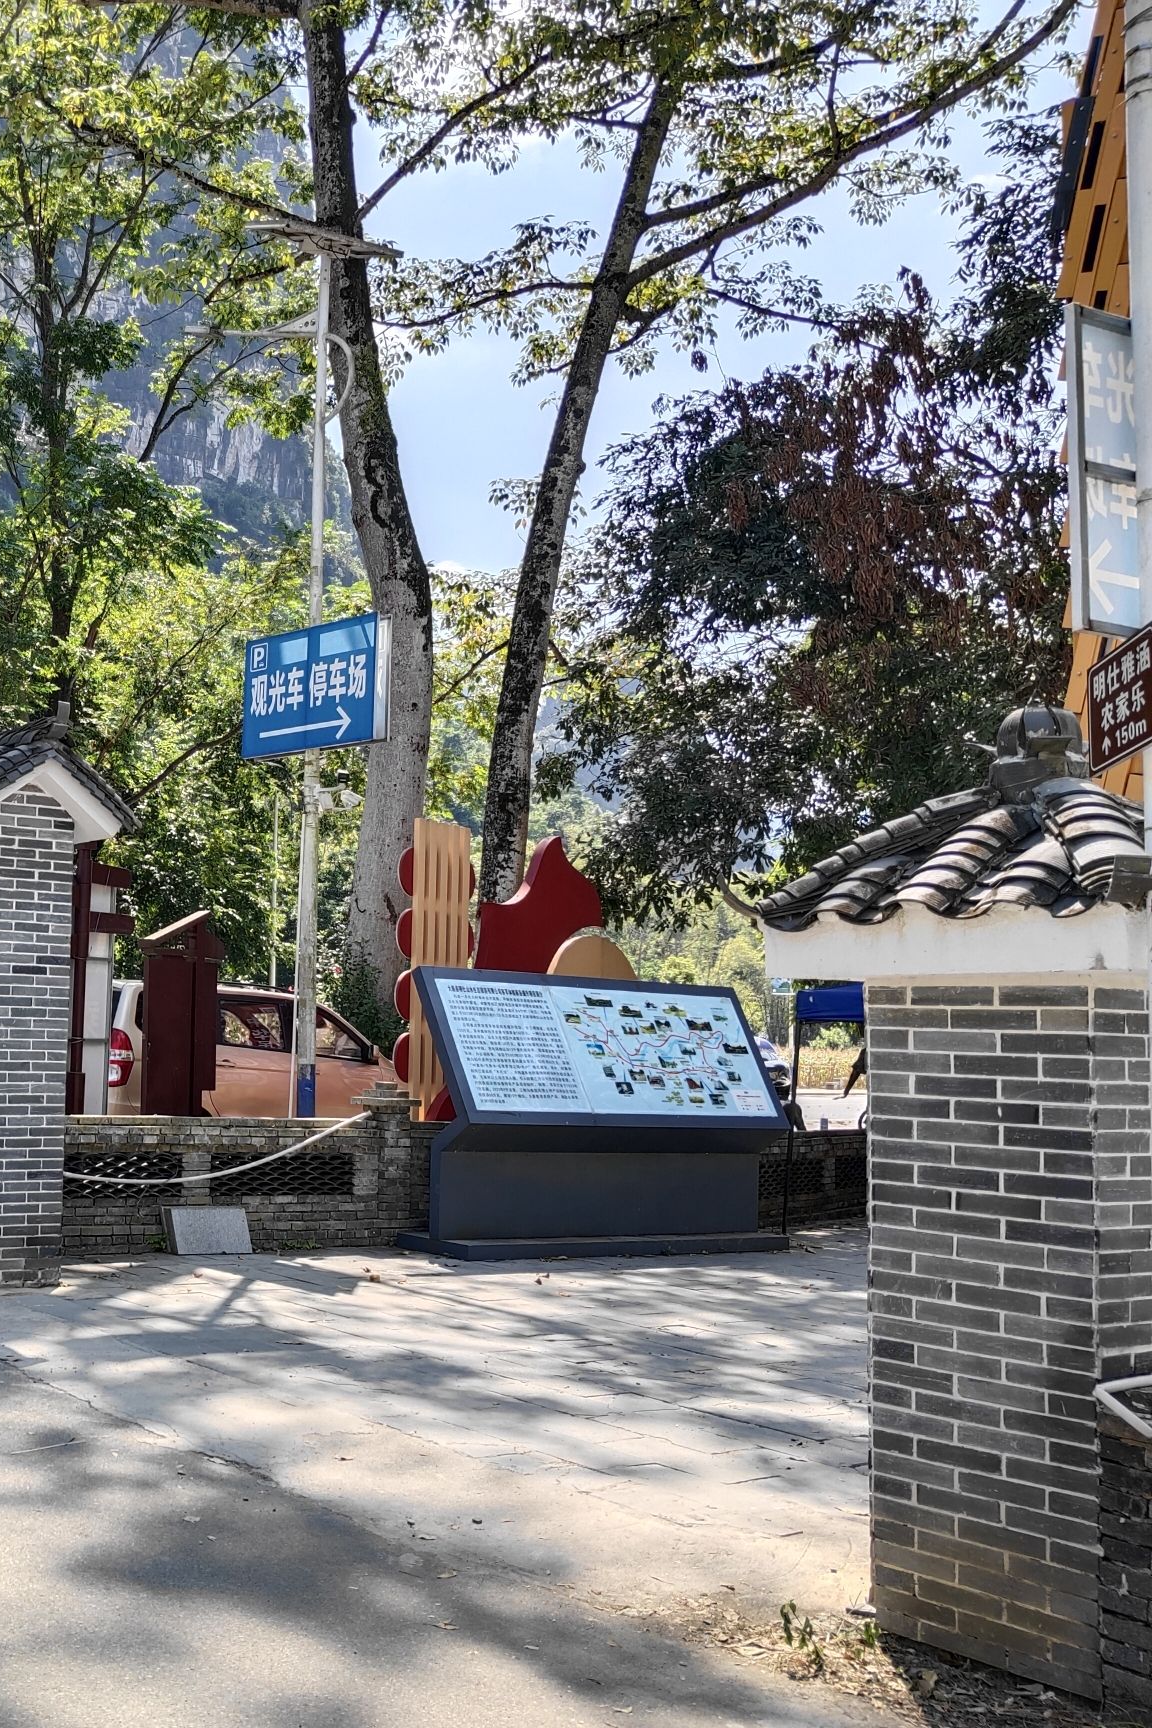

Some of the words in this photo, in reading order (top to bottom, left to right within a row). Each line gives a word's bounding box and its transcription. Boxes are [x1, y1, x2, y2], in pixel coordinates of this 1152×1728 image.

[253, 647, 265, 669] P
[1093, 639, 1151, 703] 明仕雅涵
[250, 667, 304, 718] 观光车
[309, 654, 367, 708] 停车场
[1100, 680, 1146, 732] 农家乐
[1115, 719, 1147, 748] 150m
